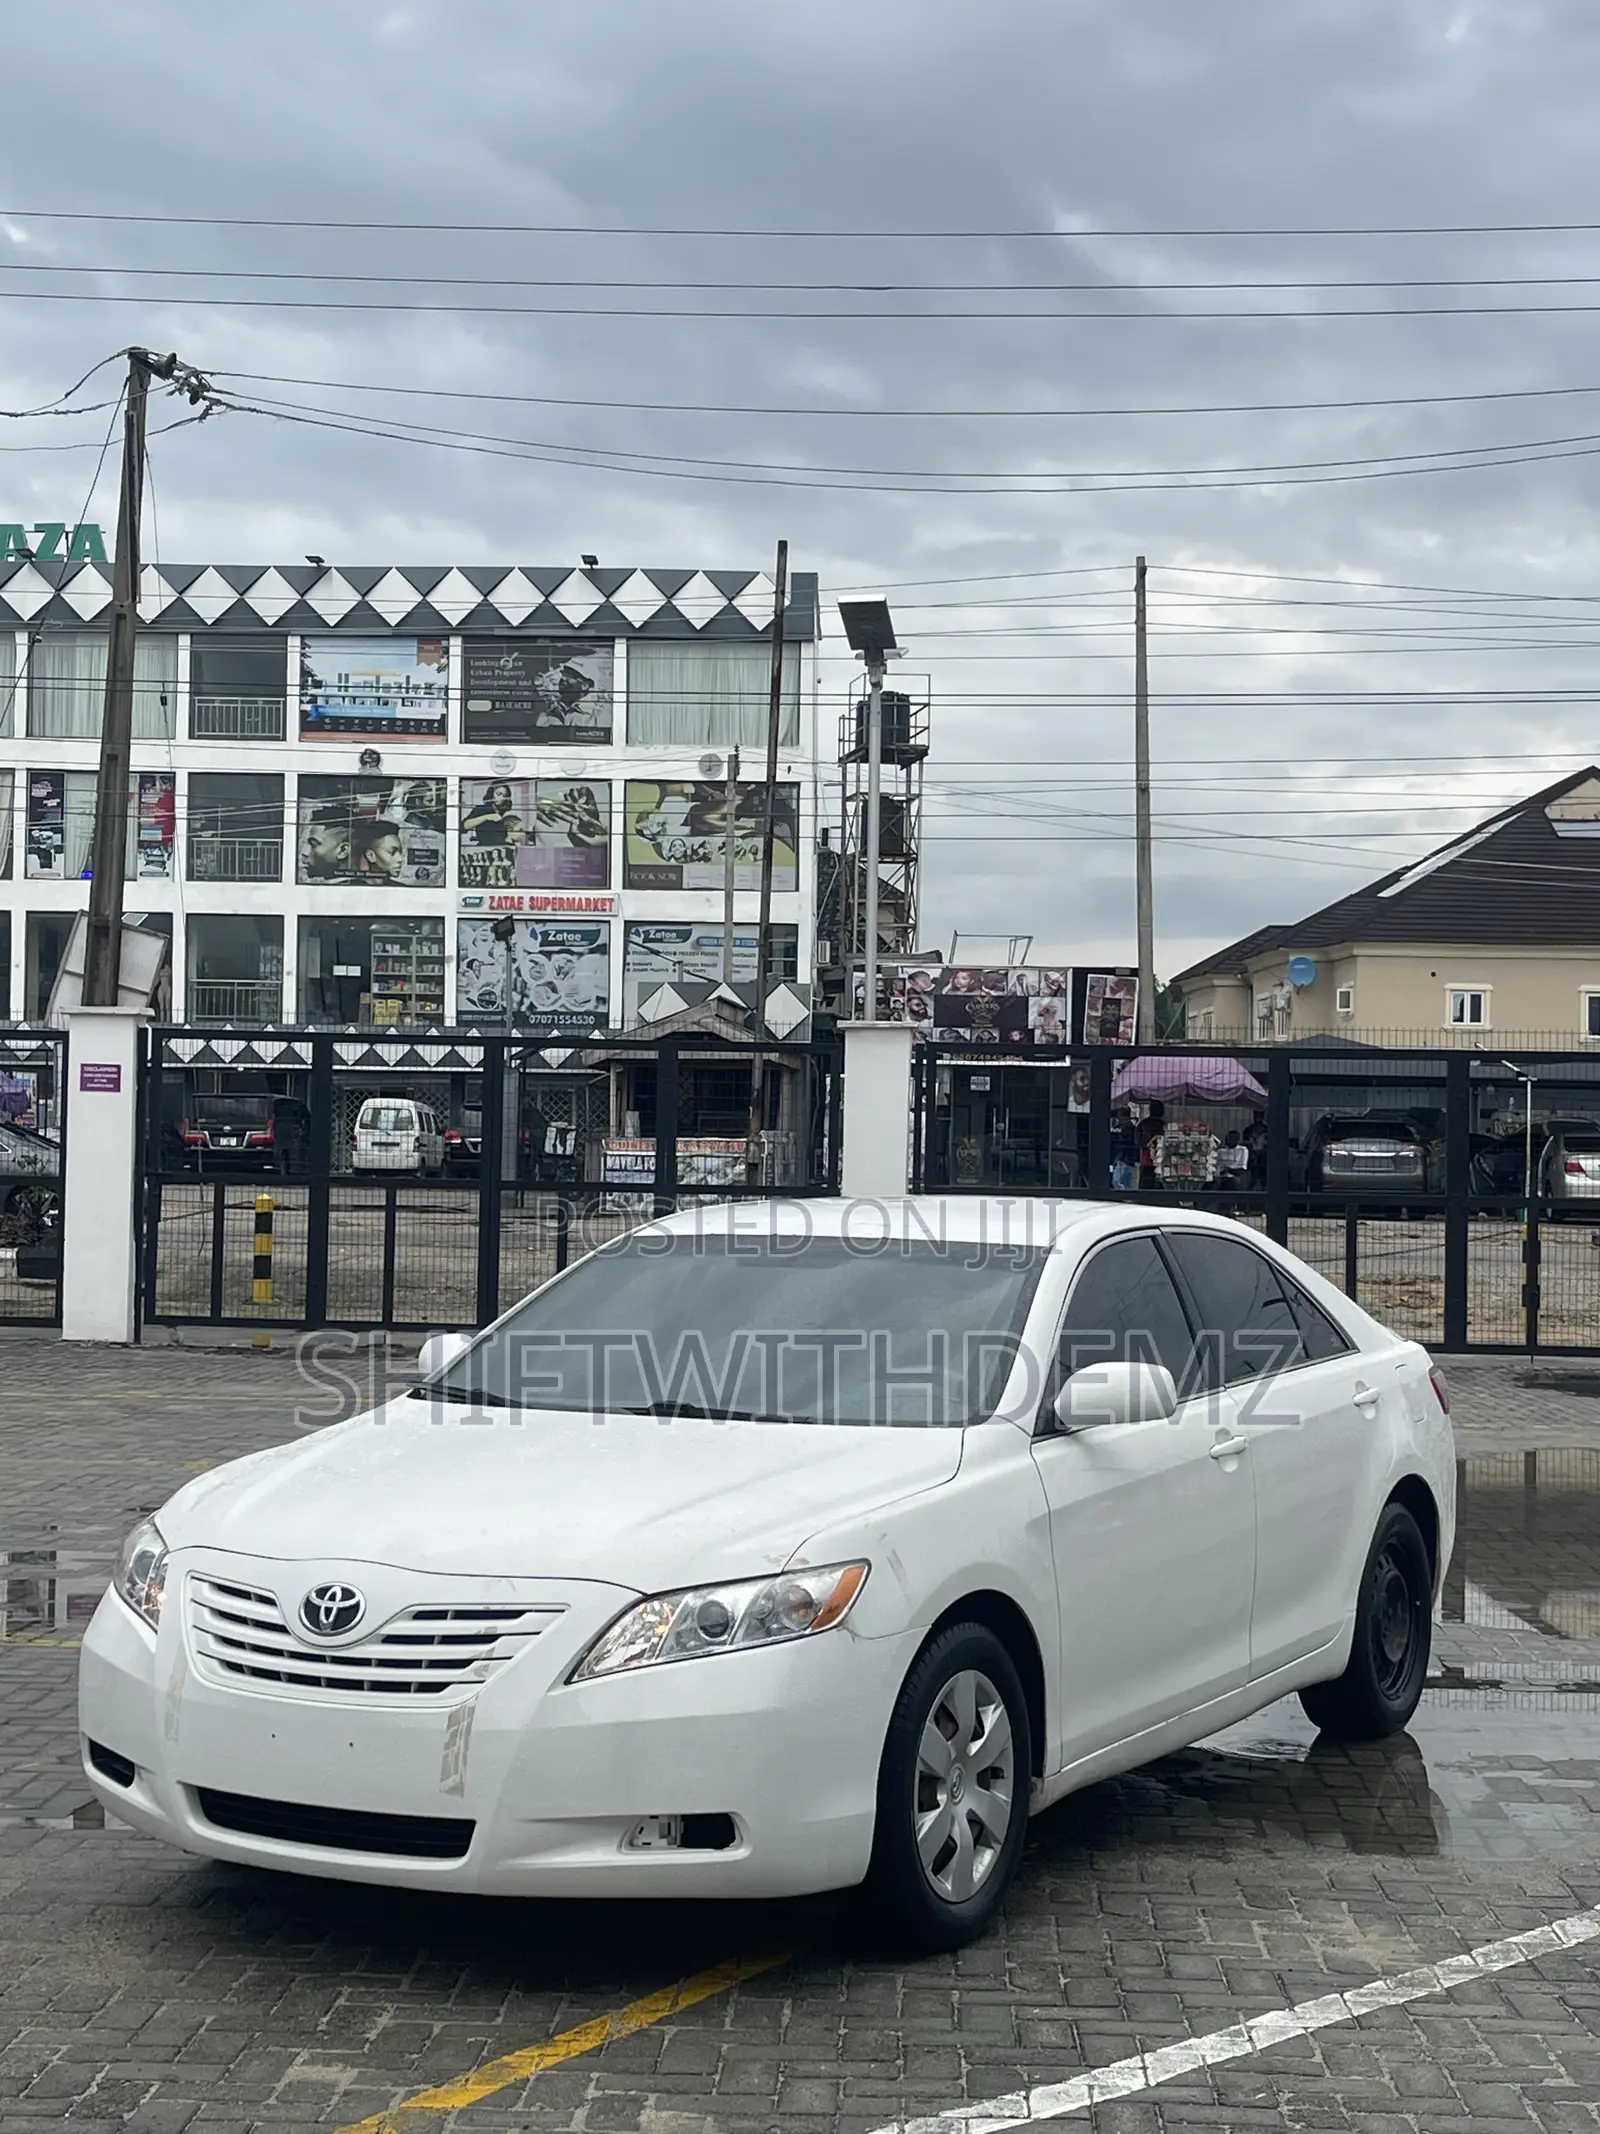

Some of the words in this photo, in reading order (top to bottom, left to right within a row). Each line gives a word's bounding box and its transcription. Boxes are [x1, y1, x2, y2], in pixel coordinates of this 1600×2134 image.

[488, 896, 524, 911] ZATAE
[528, 896, 615, 912] SUPERMARKET
[547, 930, 582, 941] Zatae
[529, 1014, 595, 1025] 07071554530
